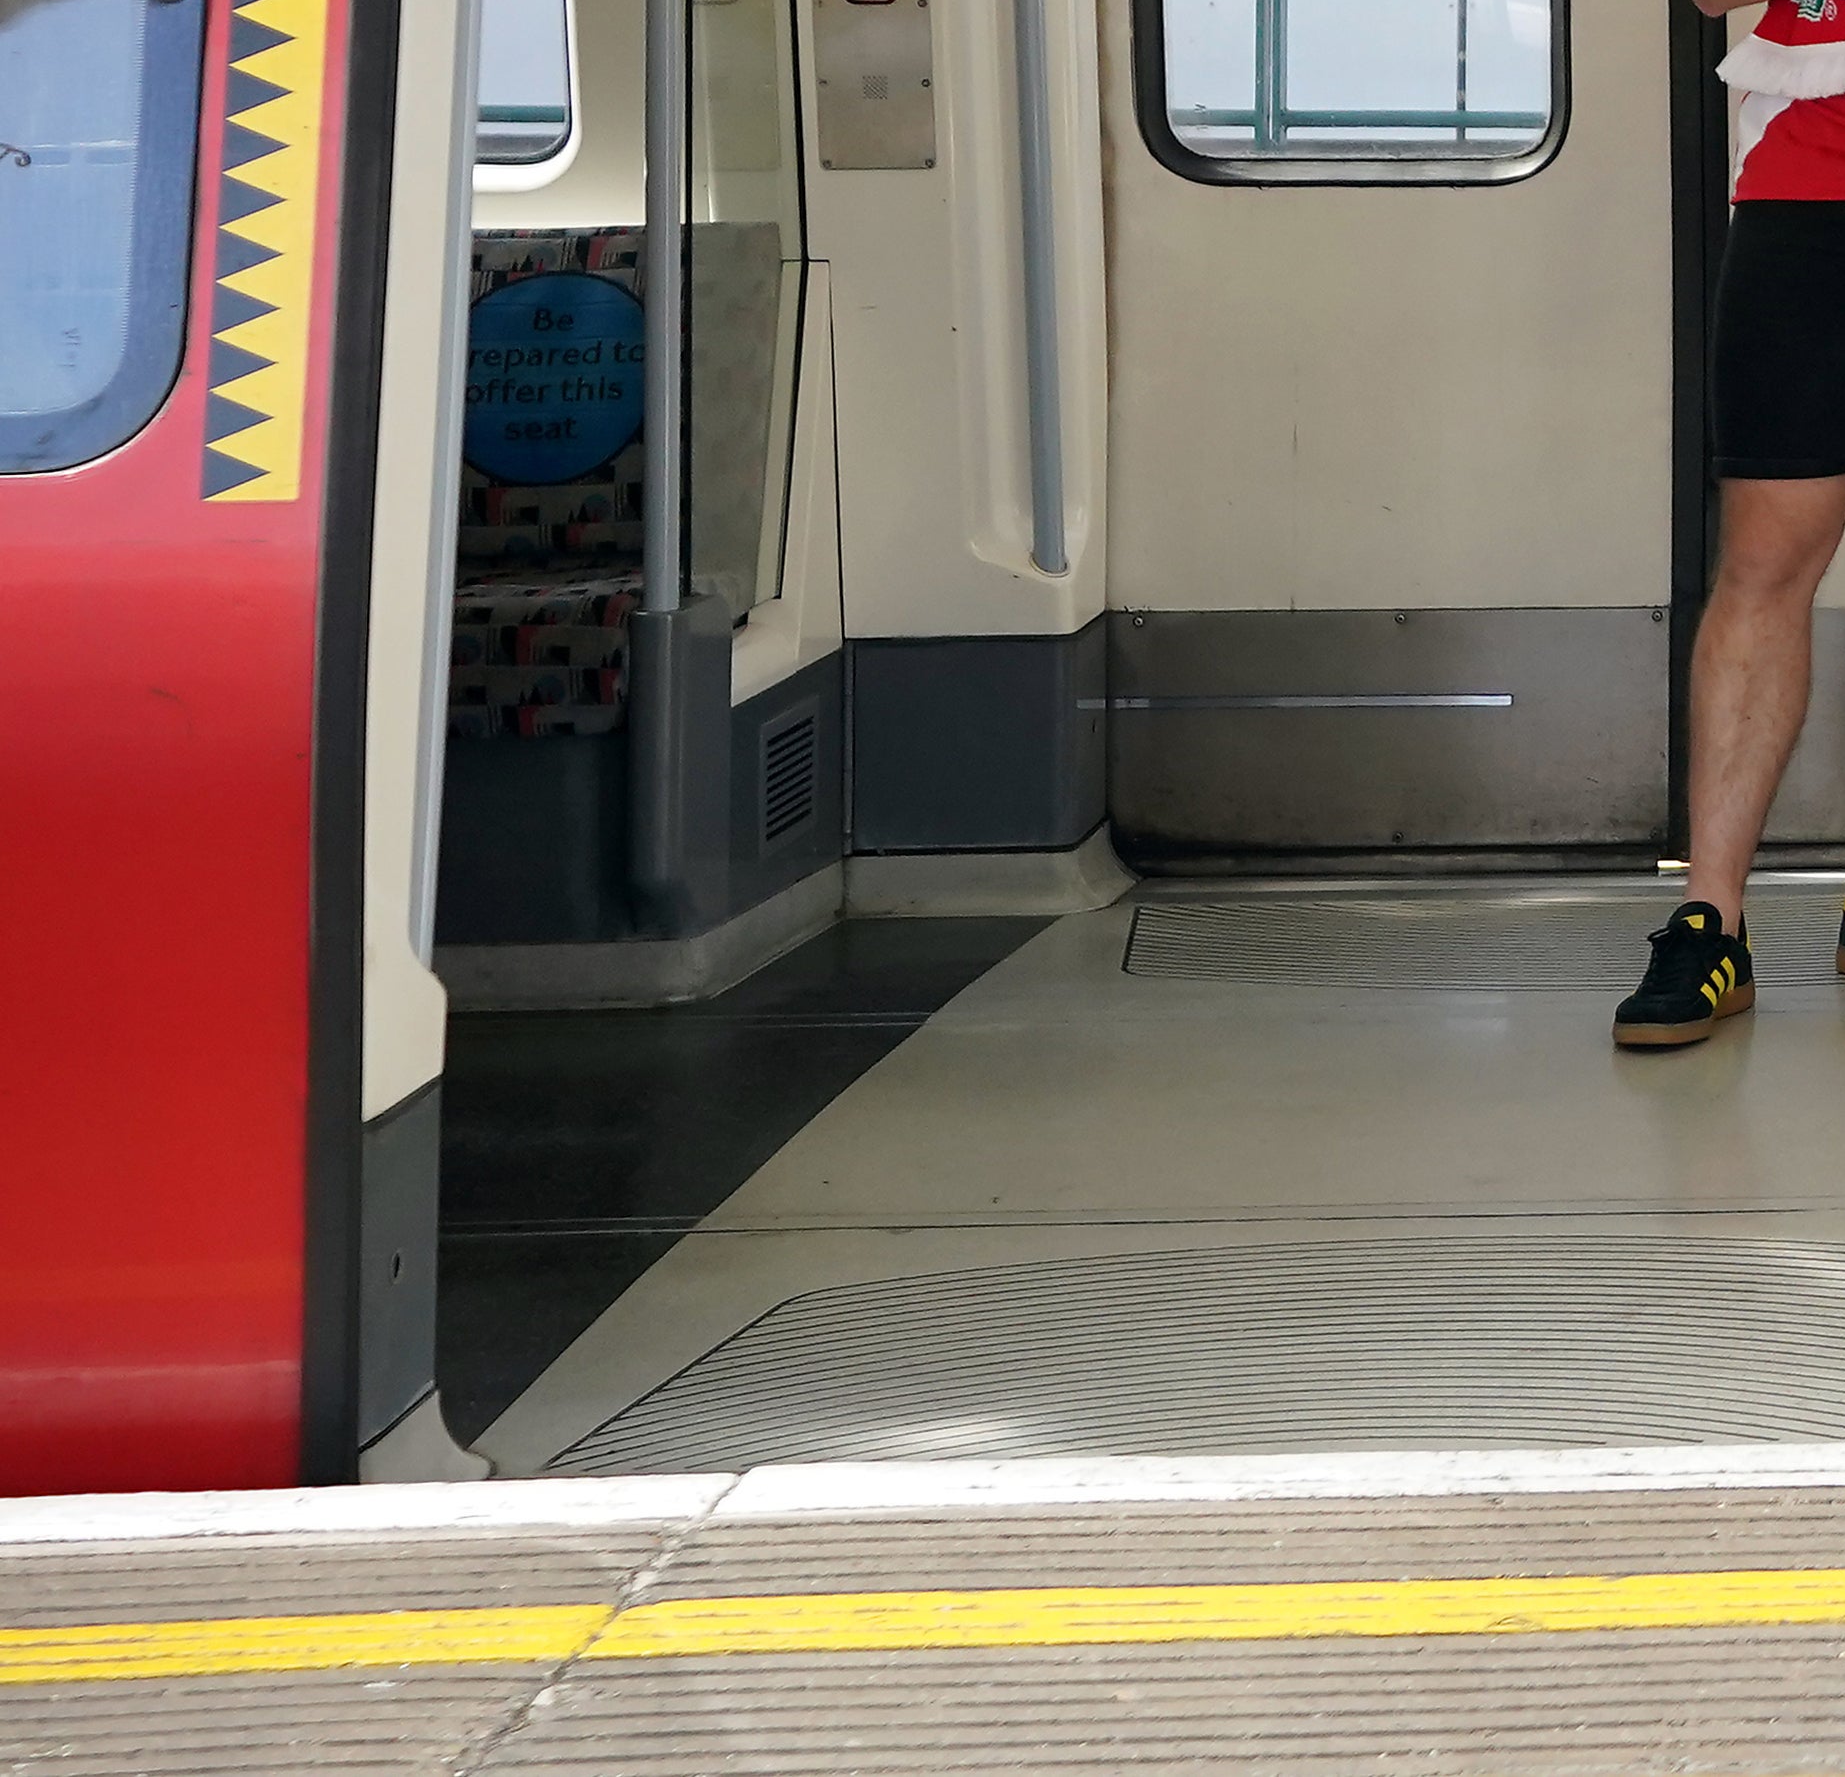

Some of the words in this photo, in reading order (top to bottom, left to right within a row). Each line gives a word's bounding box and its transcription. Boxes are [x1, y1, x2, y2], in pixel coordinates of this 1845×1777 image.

[533, 308, 574, 332] Be
[468, 340, 603, 373] repared
[466, 378, 551, 405] offer
[561, 376, 623, 402] this
[505, 418, 578, 441] seat
